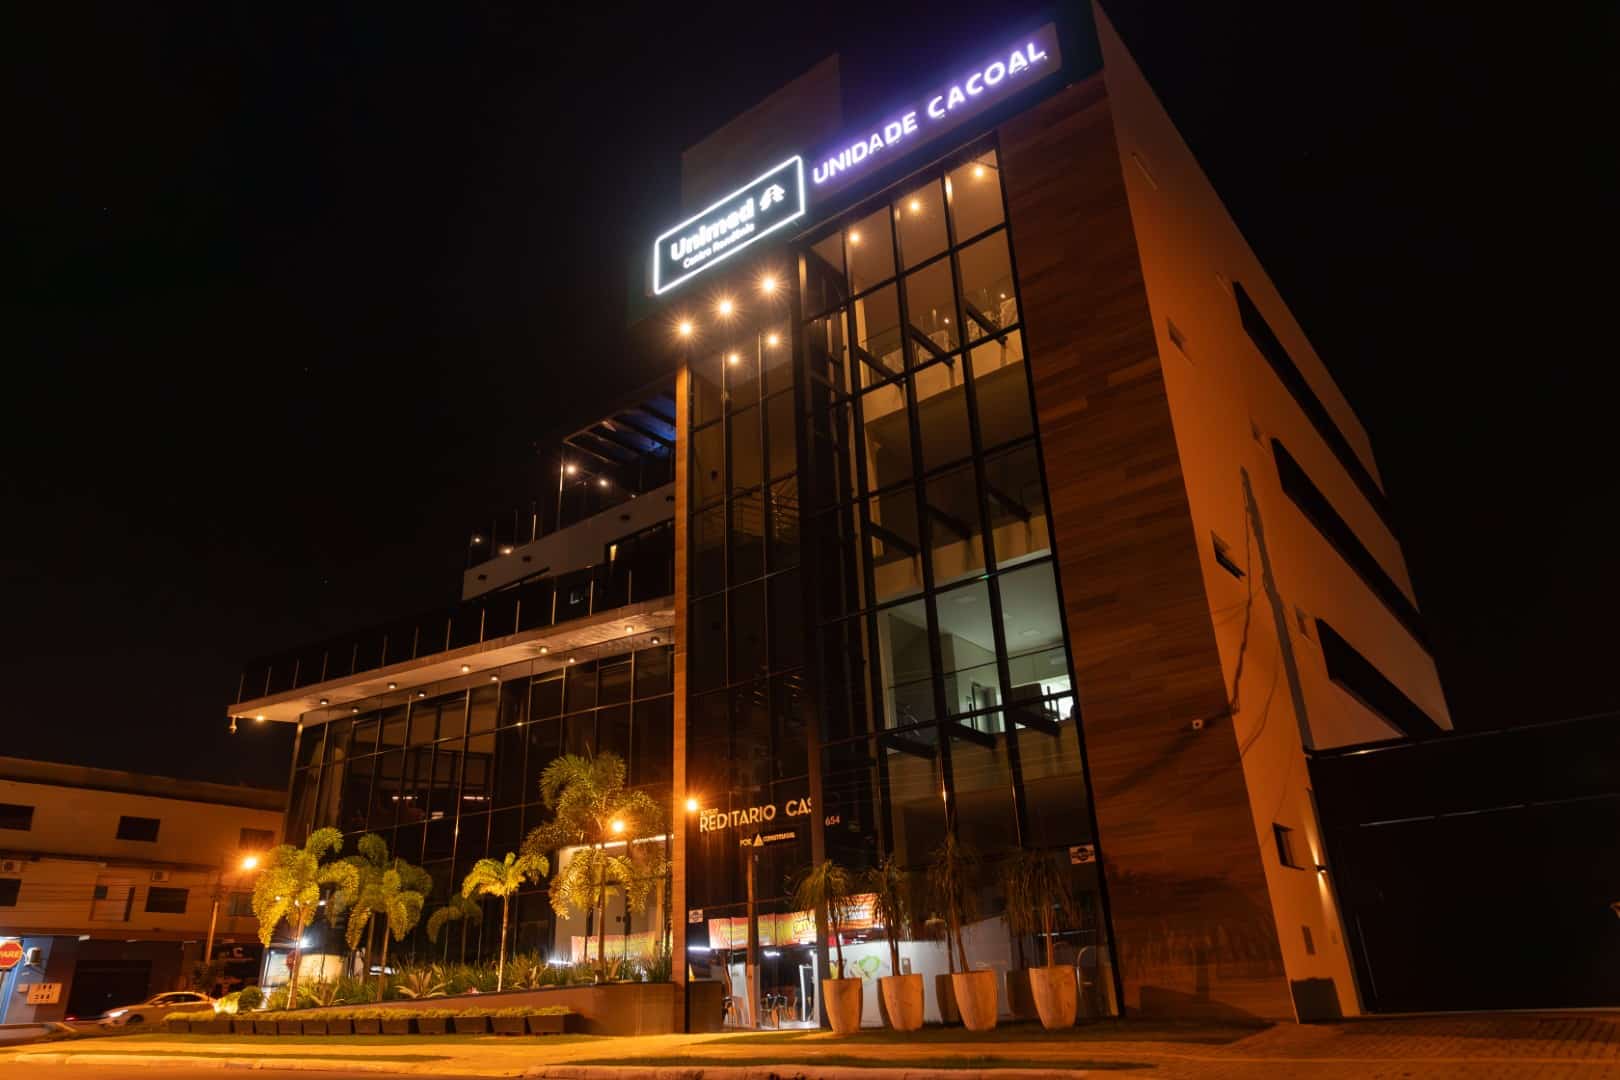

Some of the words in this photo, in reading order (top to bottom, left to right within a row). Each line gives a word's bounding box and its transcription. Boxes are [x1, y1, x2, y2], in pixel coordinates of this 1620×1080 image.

[813, 112, 918, 184] UNIDADE
[928, 43, 1046, 118] CACOAL
[671, 198, 755, 261] Unimed
